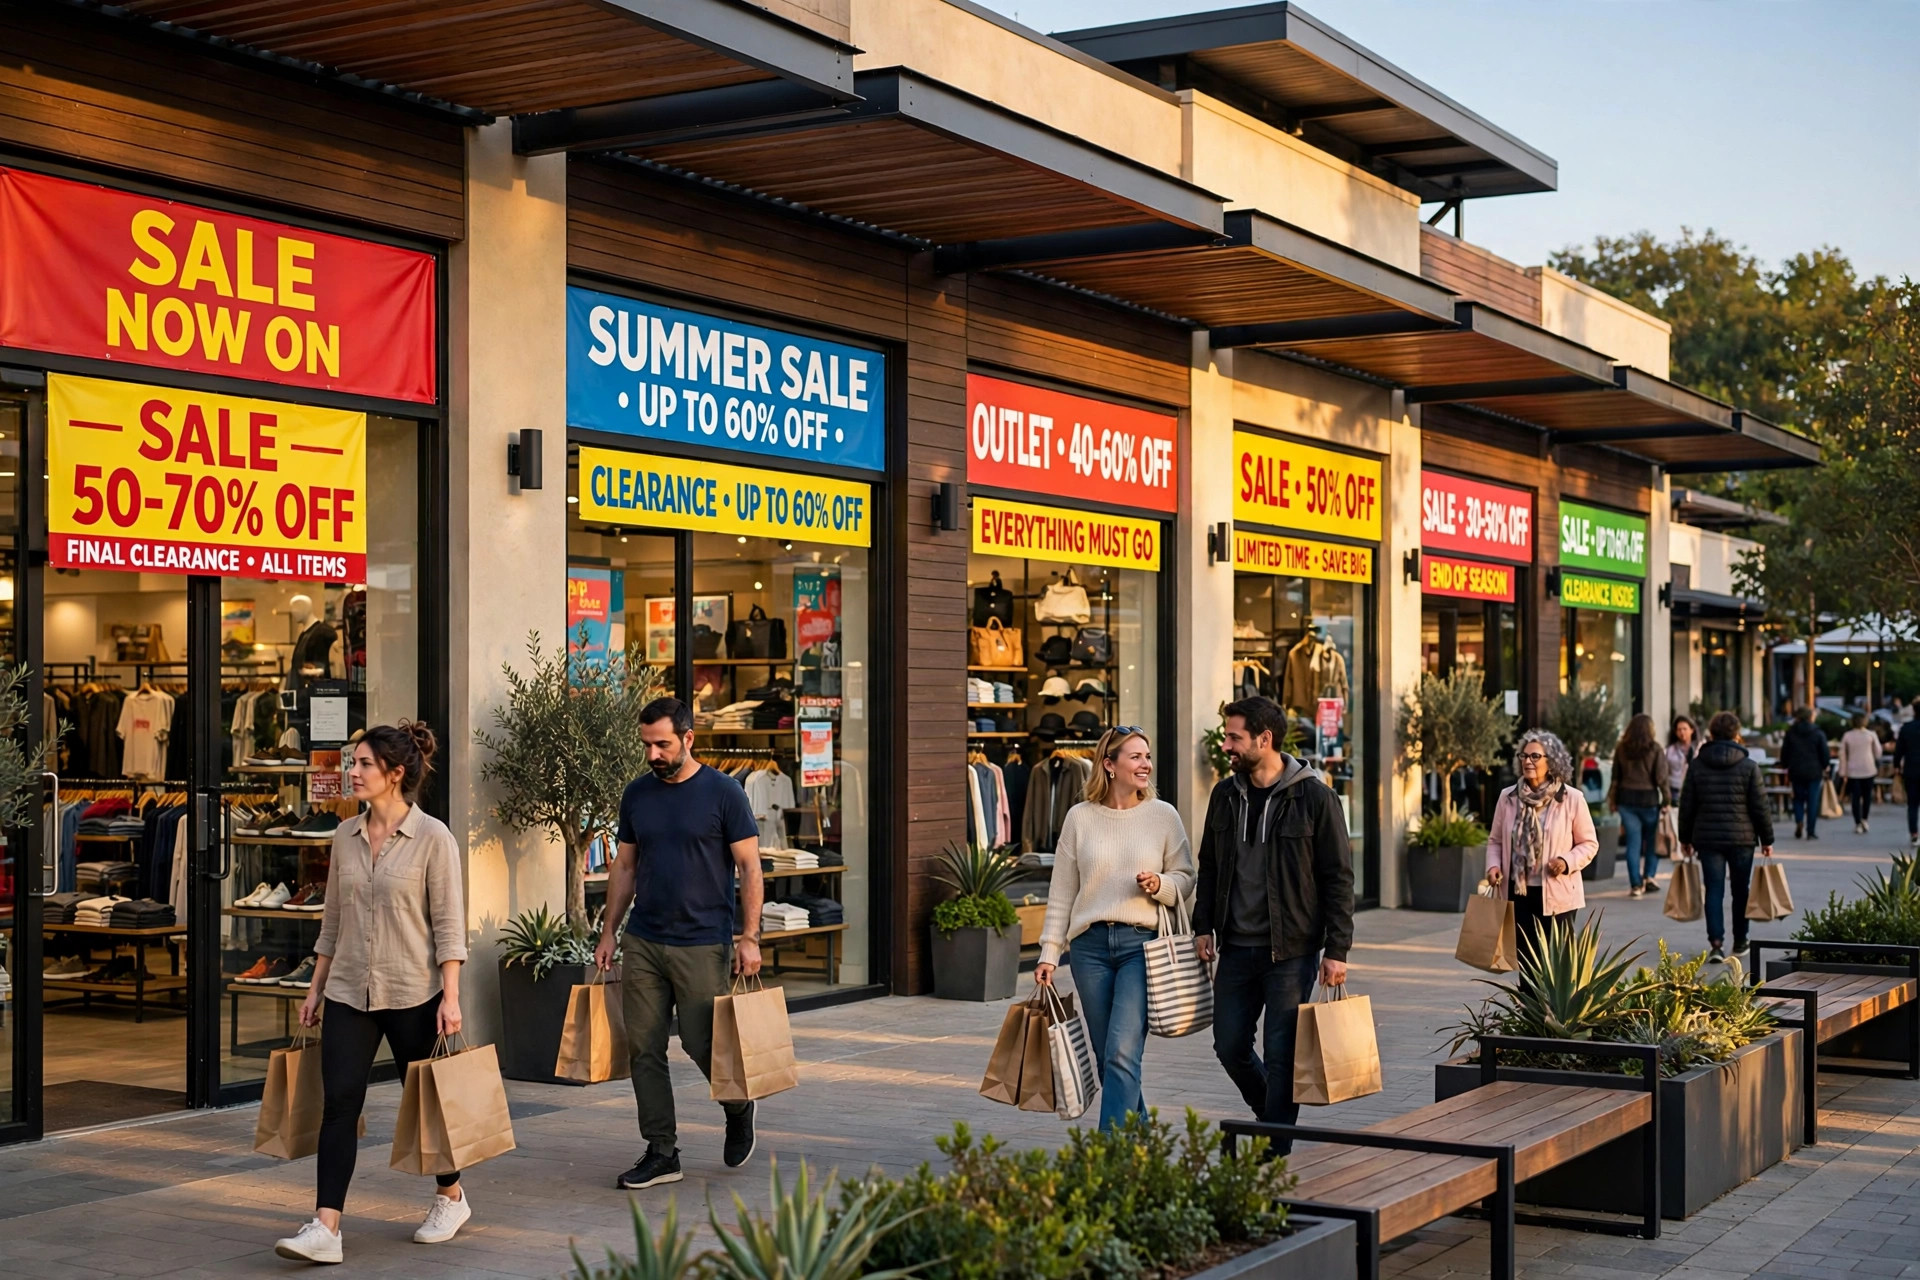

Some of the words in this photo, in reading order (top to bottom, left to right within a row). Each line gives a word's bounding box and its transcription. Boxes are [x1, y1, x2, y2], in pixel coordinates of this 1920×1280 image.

[128, 209, 315, 312] SALE
[106, 287, 251, 365] NOW
[264, 316, 340, 378] ON
[588, 305, 772, 394] SUMMER
[780, 345, 868, 412] SALE
[138, 399, 278, 472] SALE
[639, 382, 677, 428] UP
[683, 389, 718, 435] TO
[724, 397, 778, 445] 60%
[784, 407, 828, 451] OFF
[972, 402, 1053, 469] OUTLET
[1069, 423, 1137, 484] 40-60%
[1140, 436, 1172, 488] OFF
[71, 464, 263, 536] 50-70%
[275, 482, 355, 542] OFF
[591, 465, 717, 517] CLEARANCE
[736, 483, 761, 521] UP
[765, 487, 788, 525] TO
[793, 491, 829, 528] 60%
[832, 495, 863, 531] OFF
[1241, 452, 1290, 509] SALE
[1307, 466, 1341, 517] 50%
[1345, 473, 1375, 521] OFF
[1422, 488, 1456, 535] SALE
[1465, 496, 1508, 544] 30-50%
[1509, 505, 1529, 546] OFF
[67, 539, 125, 566] FINAL
[130, 543, 239, 572] CLEARANCE
[261, 552, 293, 575] ALL
[297, 554, 346, 578] ITEMS
[981, 509, 1085, 553] EVERYTHING
[1089, 522, 1129, 558] MUST
[1133, 528, 1153, 560] GO
[1236, 538, 1282, 567] LIMITED
[1285, 544, 1310, 570] TIME
[1322, 548, 1347, 574] SAVE
[1350, 552, 1366, 576] BIG
[1562, 514, 1590, 556] SALE
[1430, 561, 1452, 589] END
[1454, 565, 1467, 591] OF
[1469, 568, 1507, 595] SEASON
